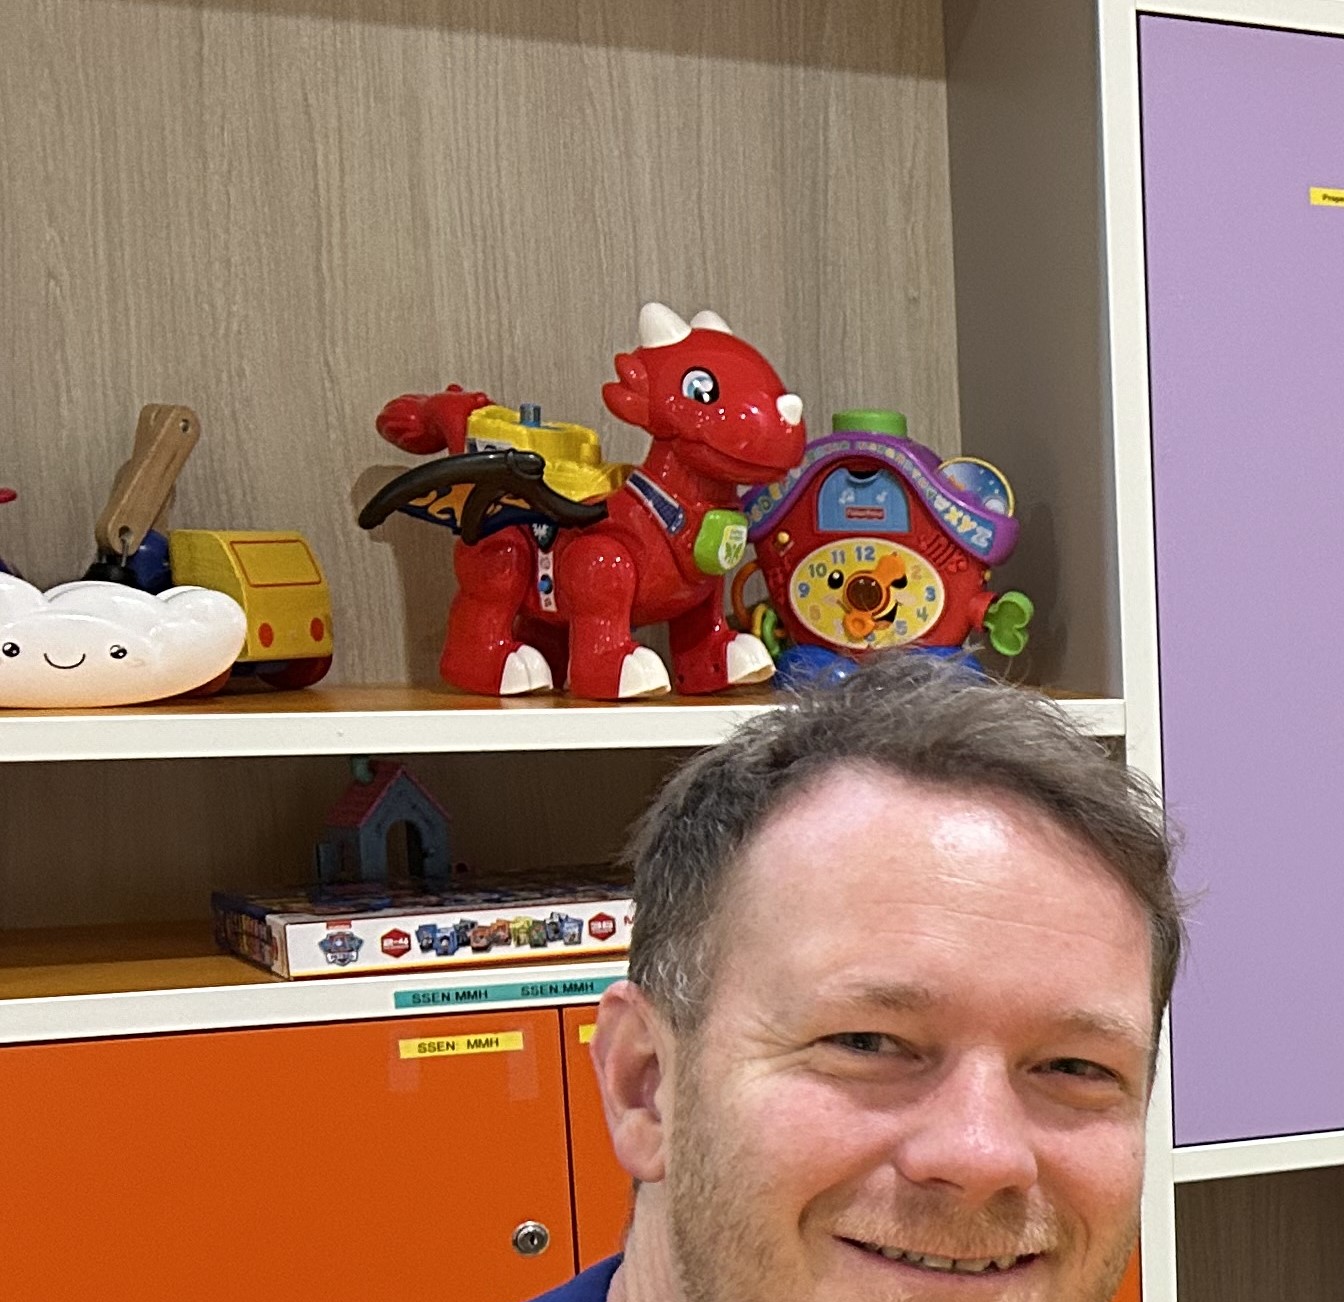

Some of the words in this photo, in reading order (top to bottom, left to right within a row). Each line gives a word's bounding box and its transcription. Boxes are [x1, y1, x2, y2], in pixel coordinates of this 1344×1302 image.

[831, 550, 846, 565] 11
[855, 545, 876, 562] 12
[808, 562, 828, 578] 10
[798, 582, 810, 598] 9
[925, 586, 937, 602] 3
[916, 606, 928, 622] 4
[895, 620, 908, 636] 5
[412, 991, 451, 1004] SSEN
[454, 988, 489, 1002] MMH
[562, 981, 594, 994] MMH
[466, 1037, 500, 1050] MMH
